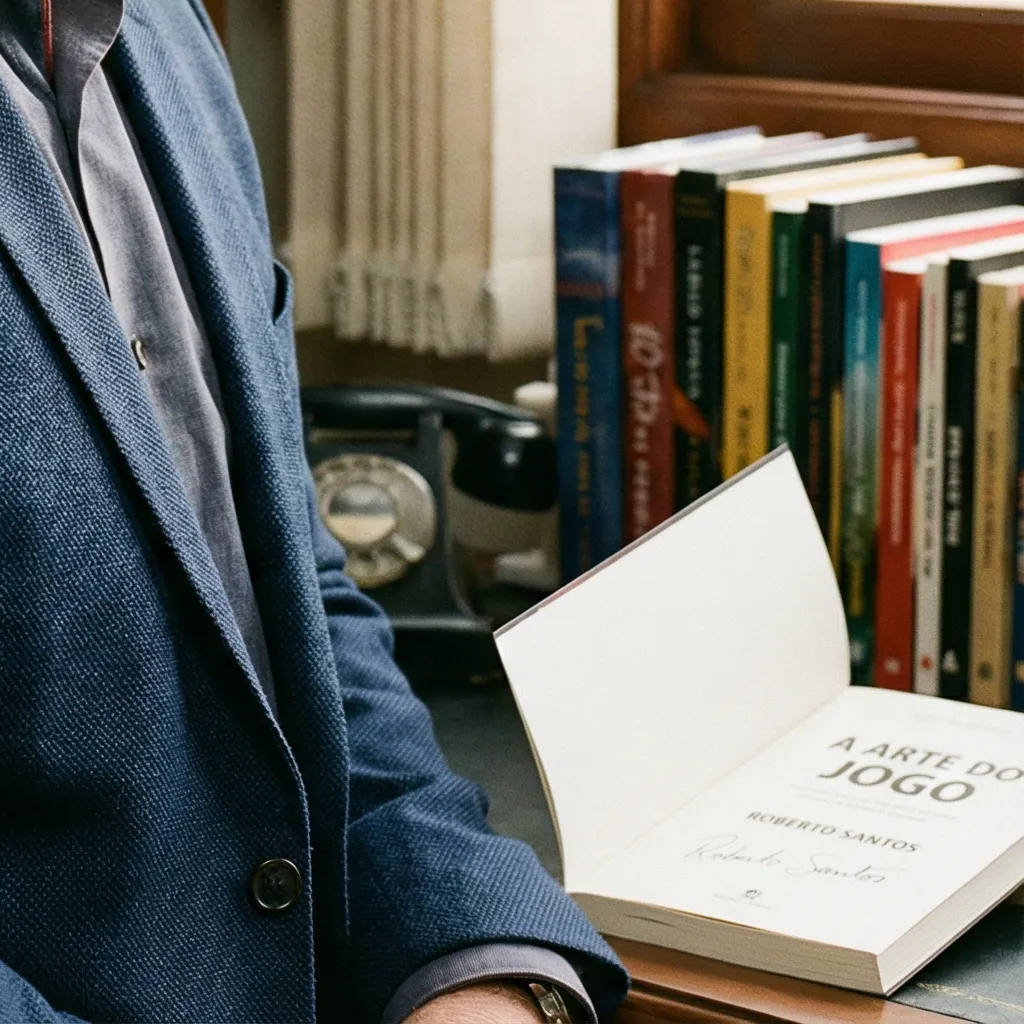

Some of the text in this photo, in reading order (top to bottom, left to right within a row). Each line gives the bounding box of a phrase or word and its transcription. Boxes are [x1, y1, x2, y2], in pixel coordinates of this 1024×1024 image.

[828, 736, 1024, 781] A ARTE DO
[818, 761, 975, 802] JOGO
[746, 811, 920, 853] ROBERTO SANTOS
